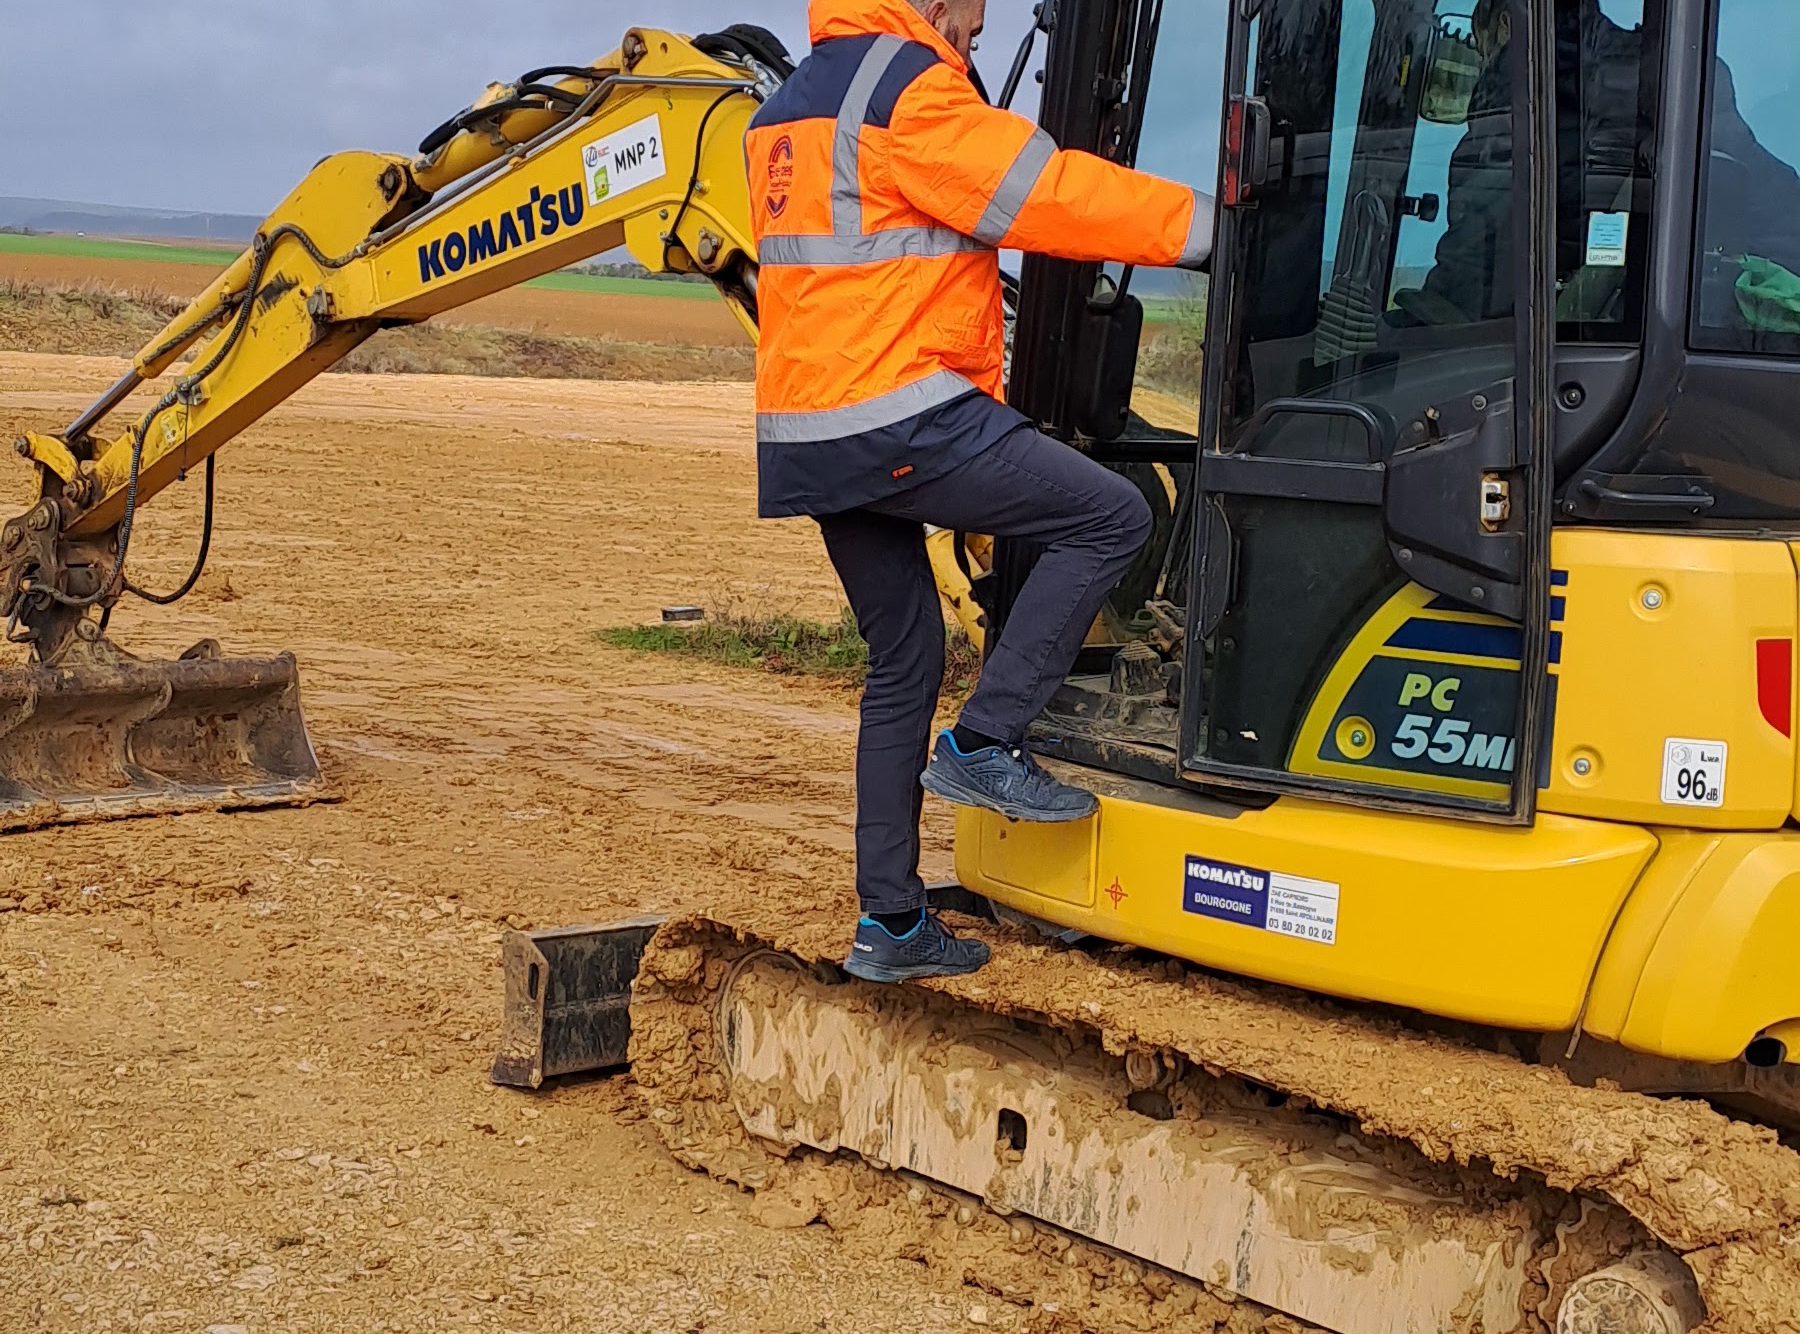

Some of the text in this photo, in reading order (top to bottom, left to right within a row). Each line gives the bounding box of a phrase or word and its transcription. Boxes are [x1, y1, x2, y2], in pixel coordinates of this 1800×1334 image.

[614, 141, 645, 174] MNP
[649, 136, 659, 158] 2
[418, 182, 584, 284] KOMATSU
[1397, 673, 1461, 711] PC
[1677, 768, 1718, 801] 96 dB
[1187, 862, 1264, 892] KOMATSU
[1194, 892, 1252, 915] BOURGOGNE
[1268, 918, 1279, 929] 03
[1282, 921, 1293, 931] 80
[1308, 926, 1319, 938] 02
[1321, 929, 1333, 941] 02
